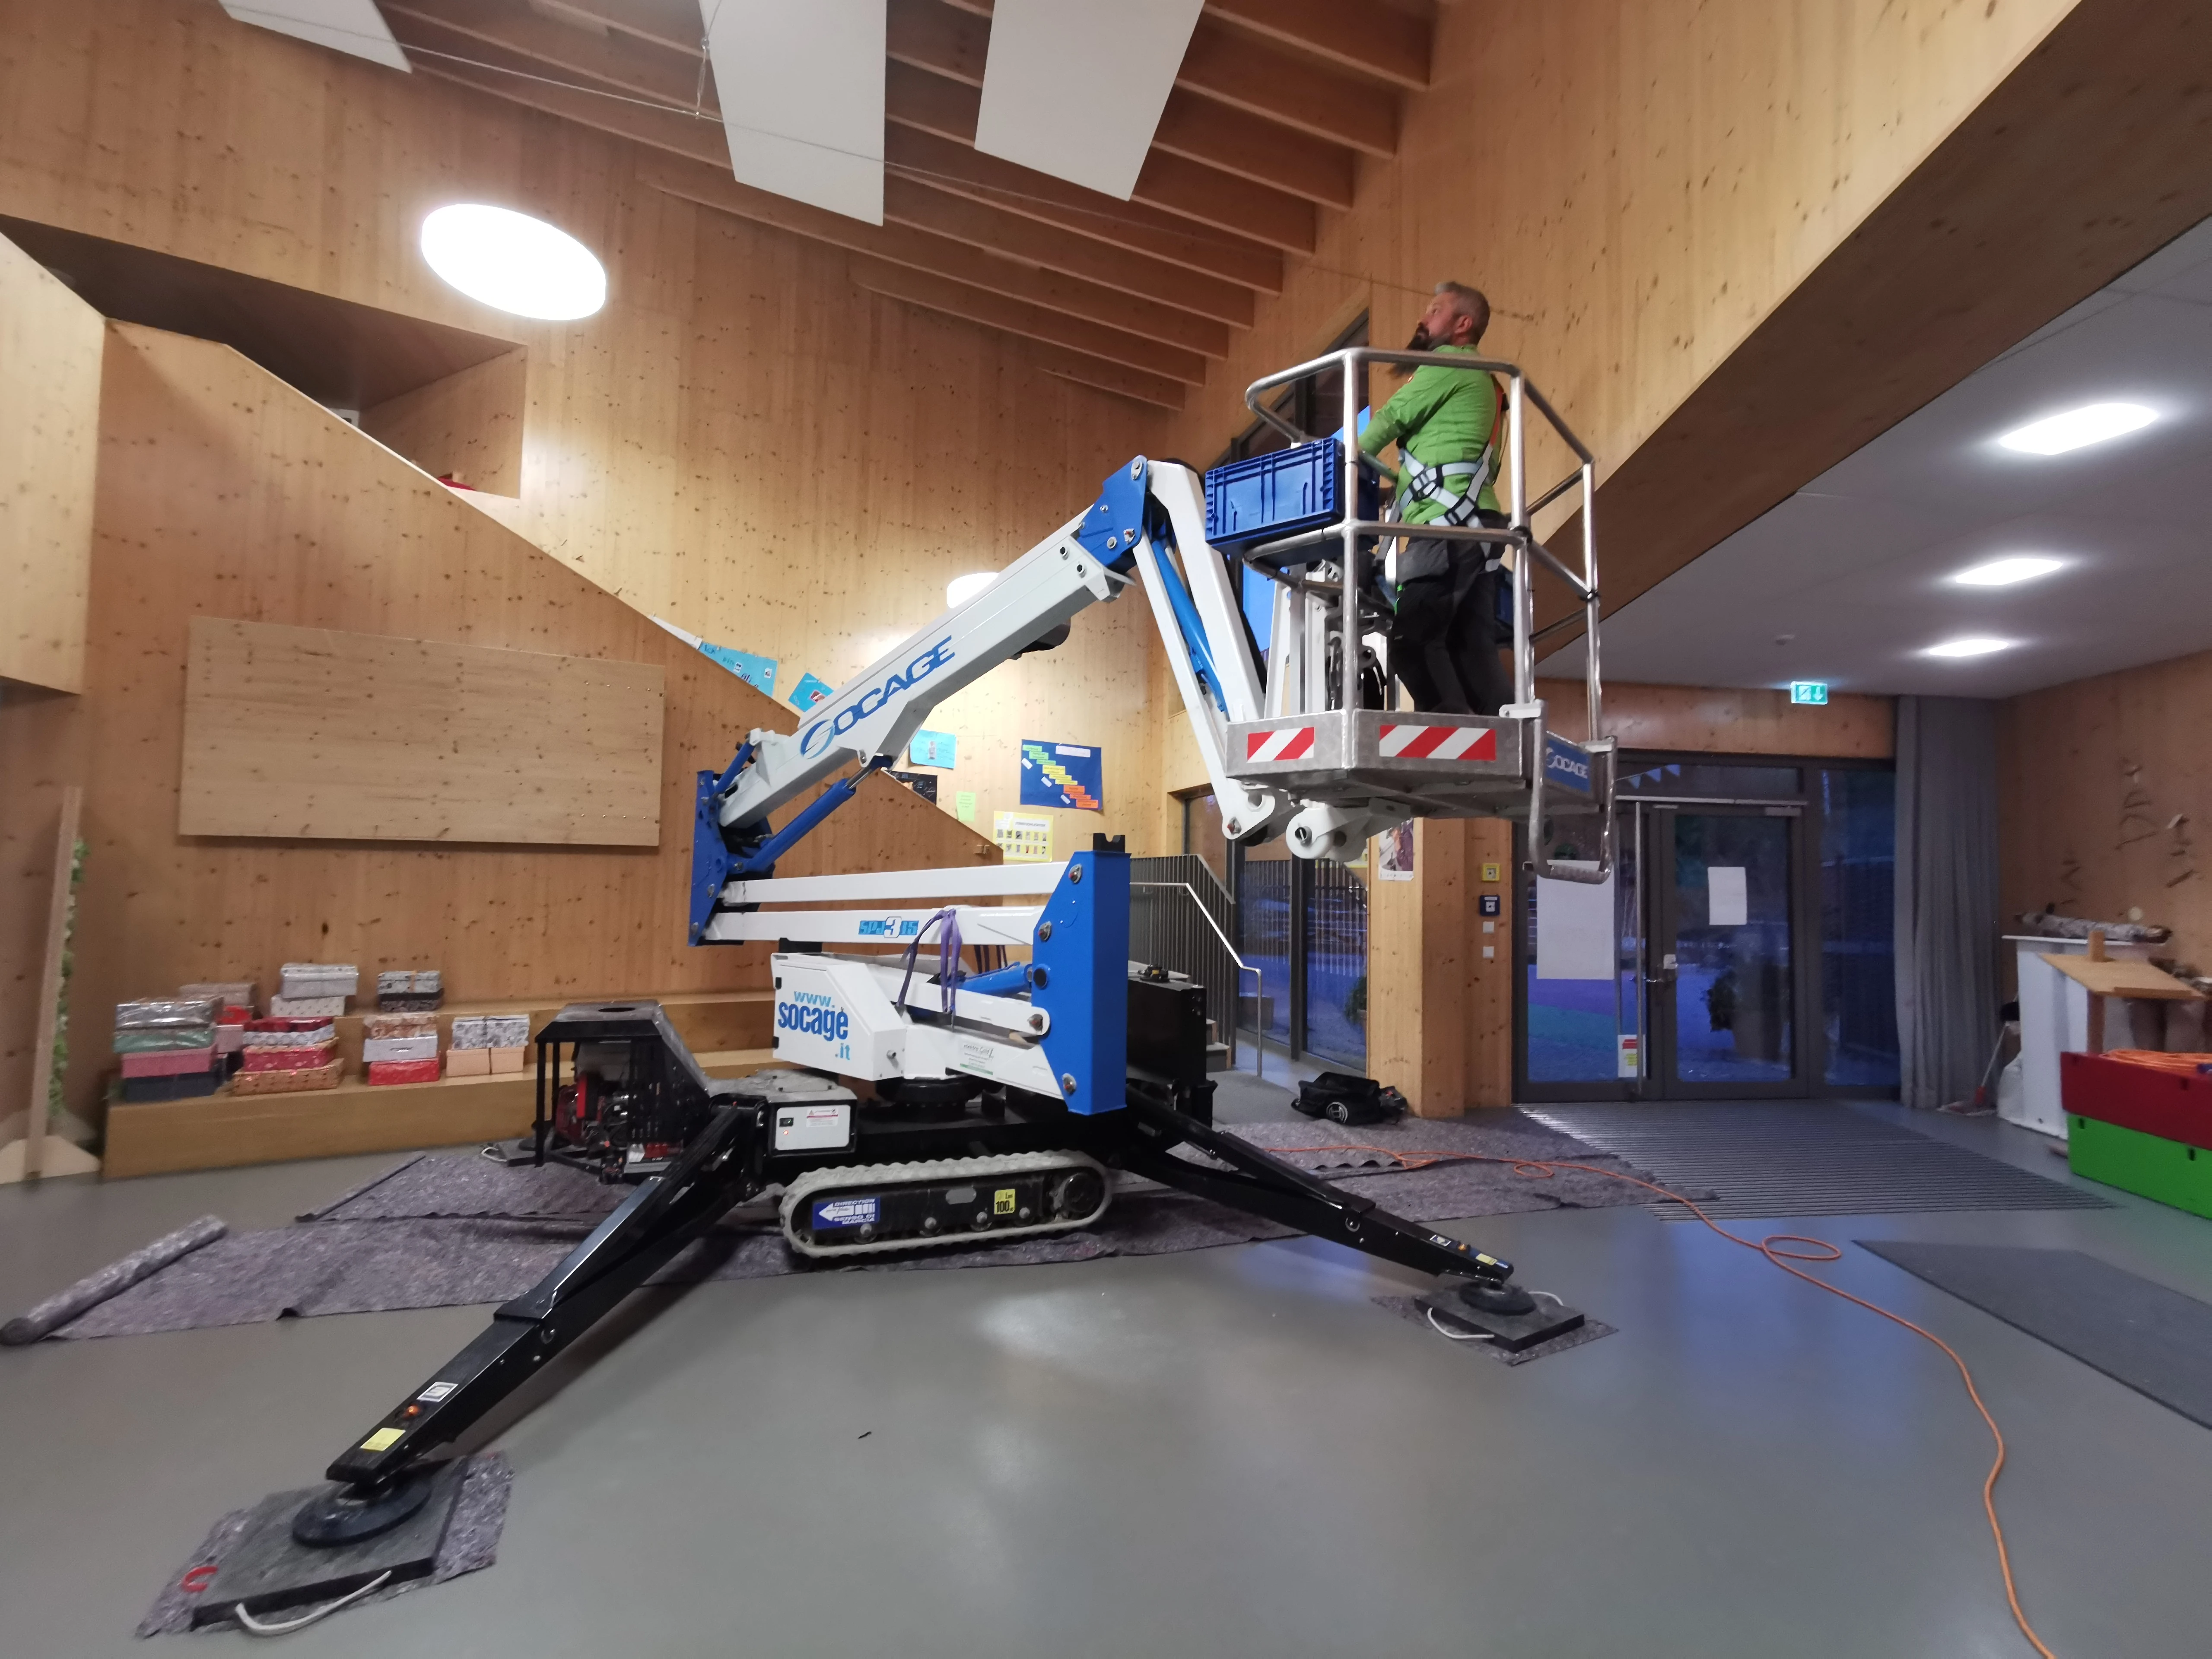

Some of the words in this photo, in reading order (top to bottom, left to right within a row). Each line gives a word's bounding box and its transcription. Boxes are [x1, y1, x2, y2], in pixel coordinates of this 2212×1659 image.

[794, 991, 835, 1008] www.
[778, 1001, 849, 1042] socage
[835, 1042, 850, 1061] .it
[996, 1200, 1010, 1213] 100
